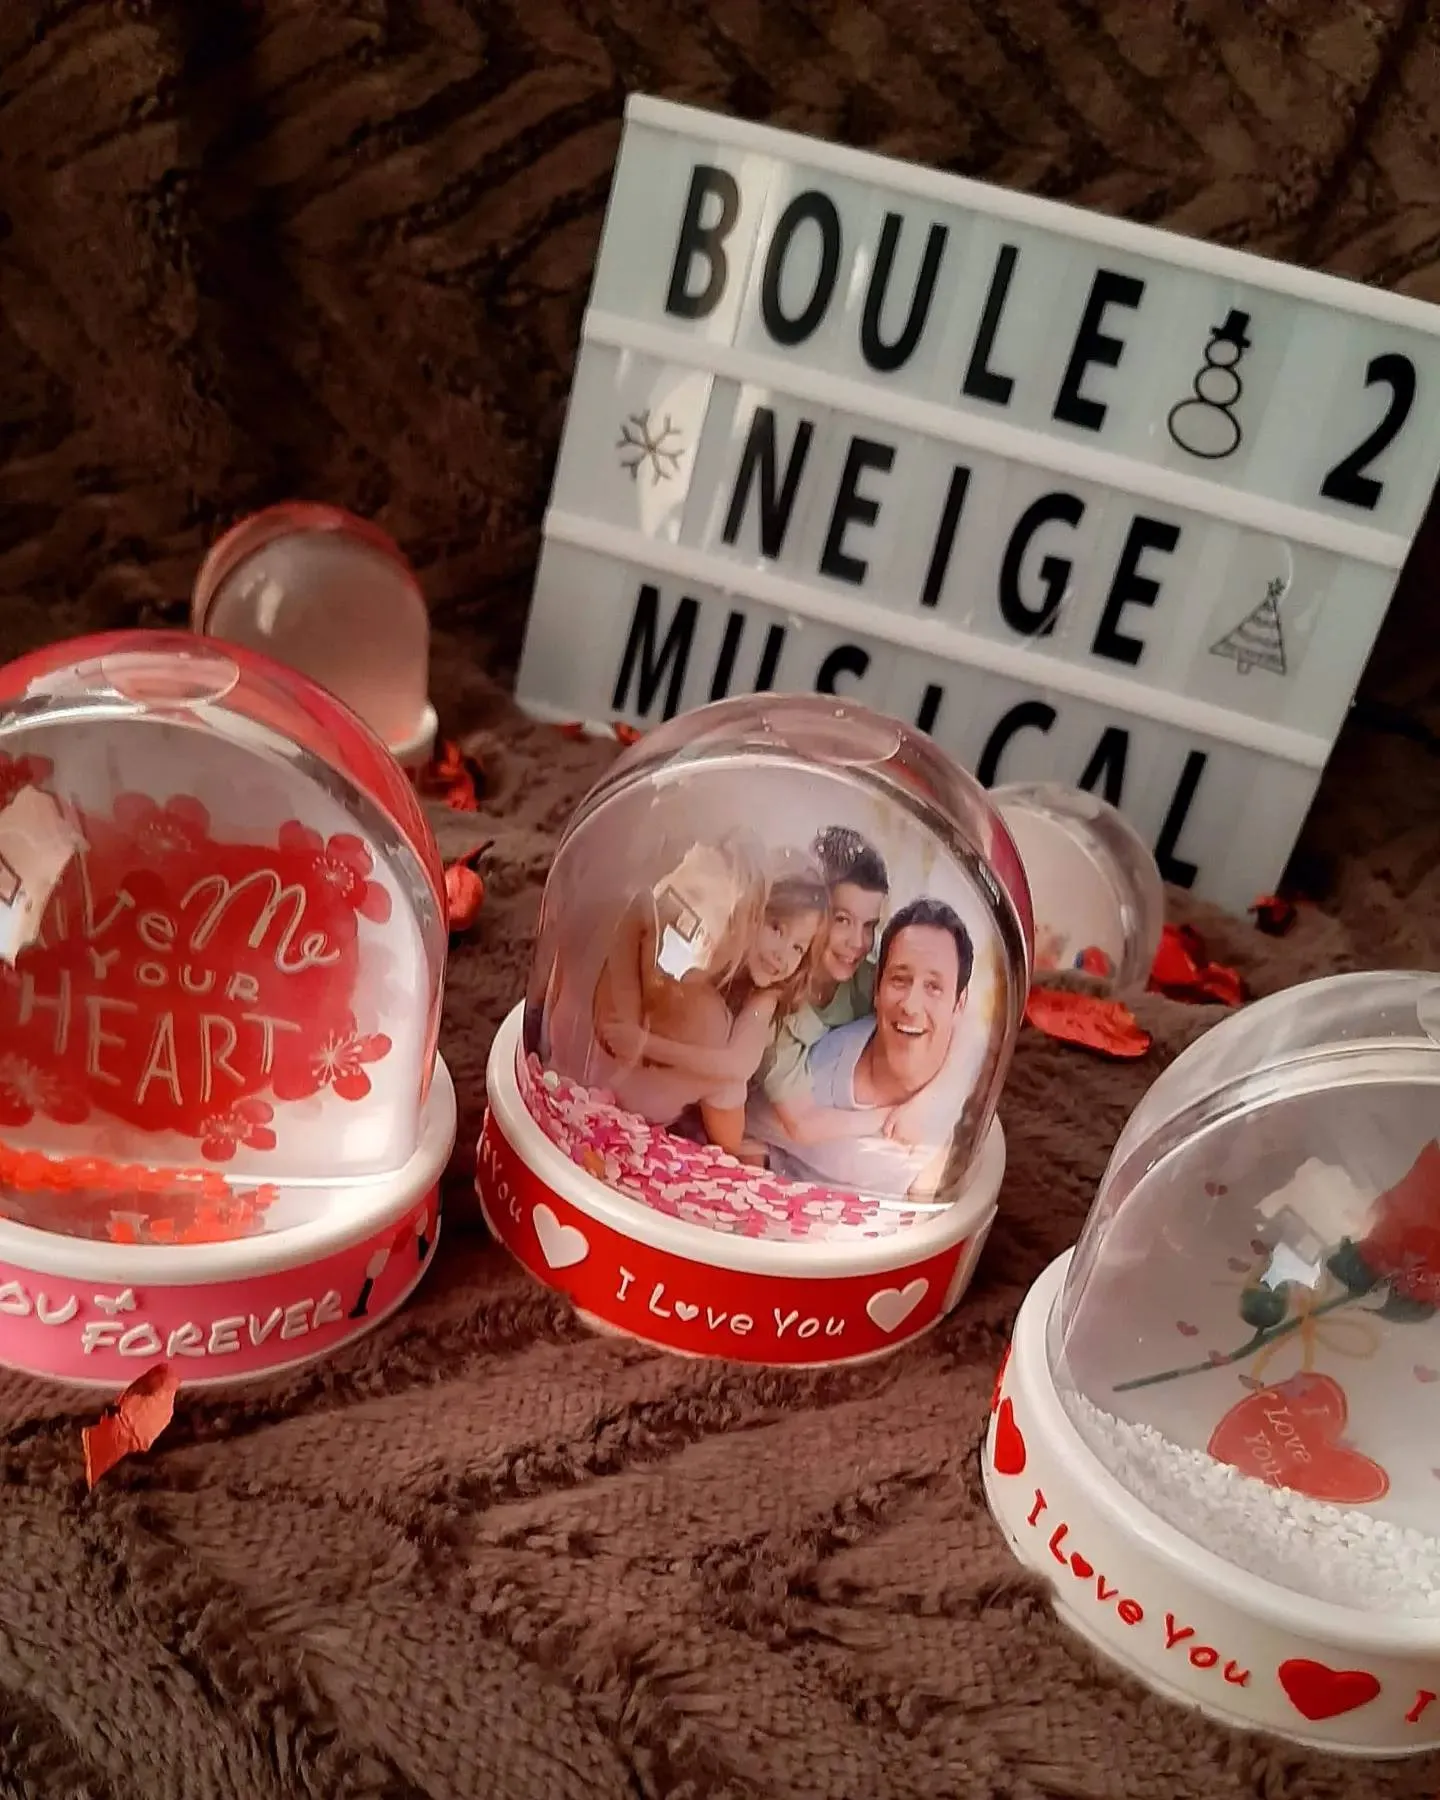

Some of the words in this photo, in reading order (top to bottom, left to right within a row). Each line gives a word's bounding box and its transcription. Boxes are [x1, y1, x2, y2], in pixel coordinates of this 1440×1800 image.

[665, 164, 1146, 433] BOULE
[1320, 352, 1417, 511] 2
[722, 407, 1182, 667] NEIGE
[88, 946, 260, 1003] YOUR
[179, 868, 342, 974] Me
[19, 967, 303, 1106] HEART
[80, 1288, 344, 1359] FOREVER
[616, 1265, 636, 1302] I
[773, 1306, 846, 1339] You
[1026, 1488, 1049, 1527] I
[1163, 1612, 1252, 1688] You
